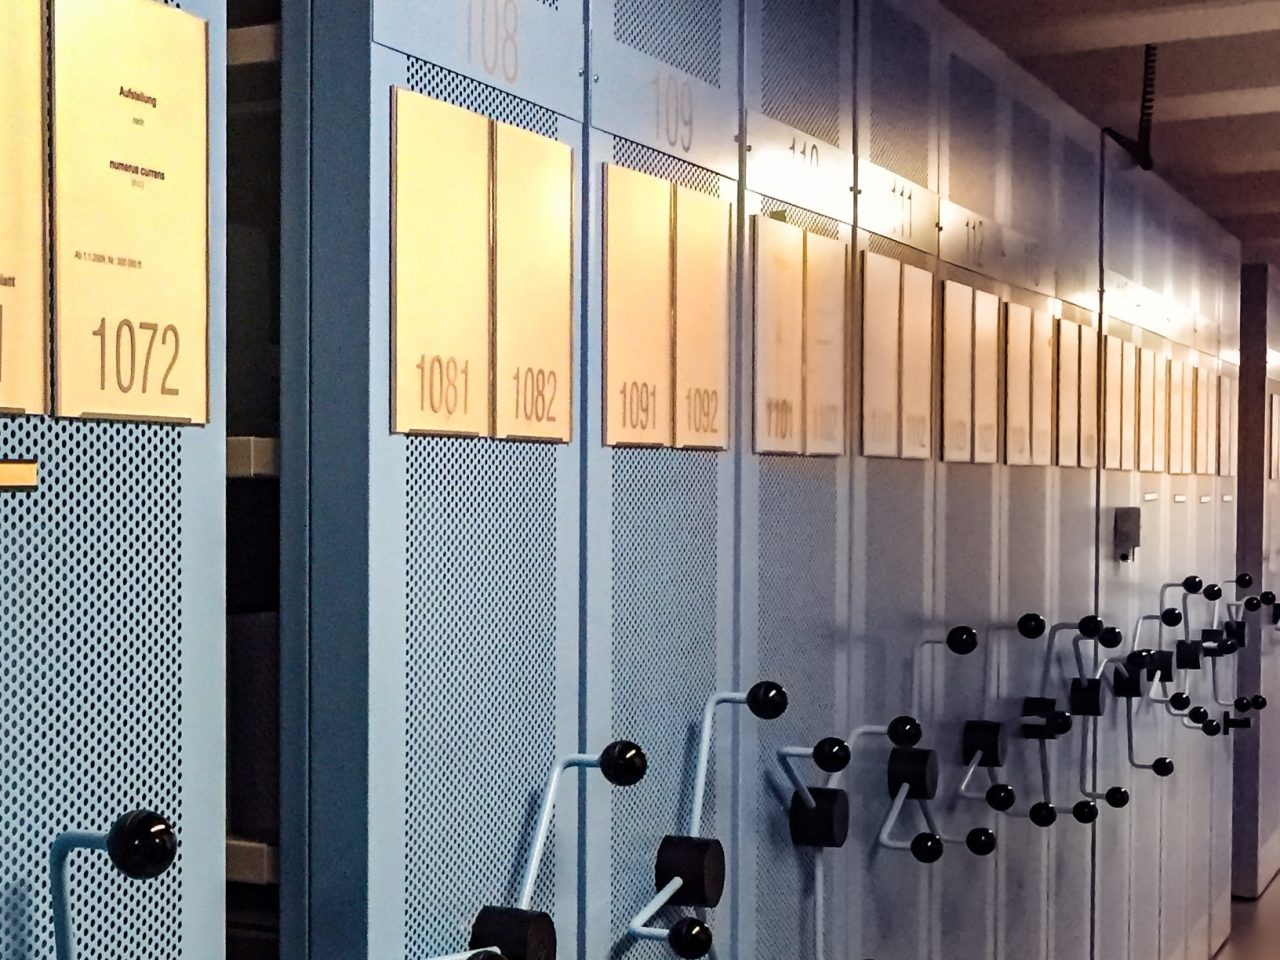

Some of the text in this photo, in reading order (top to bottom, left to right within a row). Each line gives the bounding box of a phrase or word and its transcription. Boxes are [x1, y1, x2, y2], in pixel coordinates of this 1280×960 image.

[651, 68, 695, 153] 109
[109, 160, 166, 181] numerus currens
[91, 316, 181, 396] 1072
[415, 353, 469, 416] 1081
[512, 366, 558, 422] 1082
[619, 381, 657, 430] 1091
[685, 387, 719, 434] 1092
